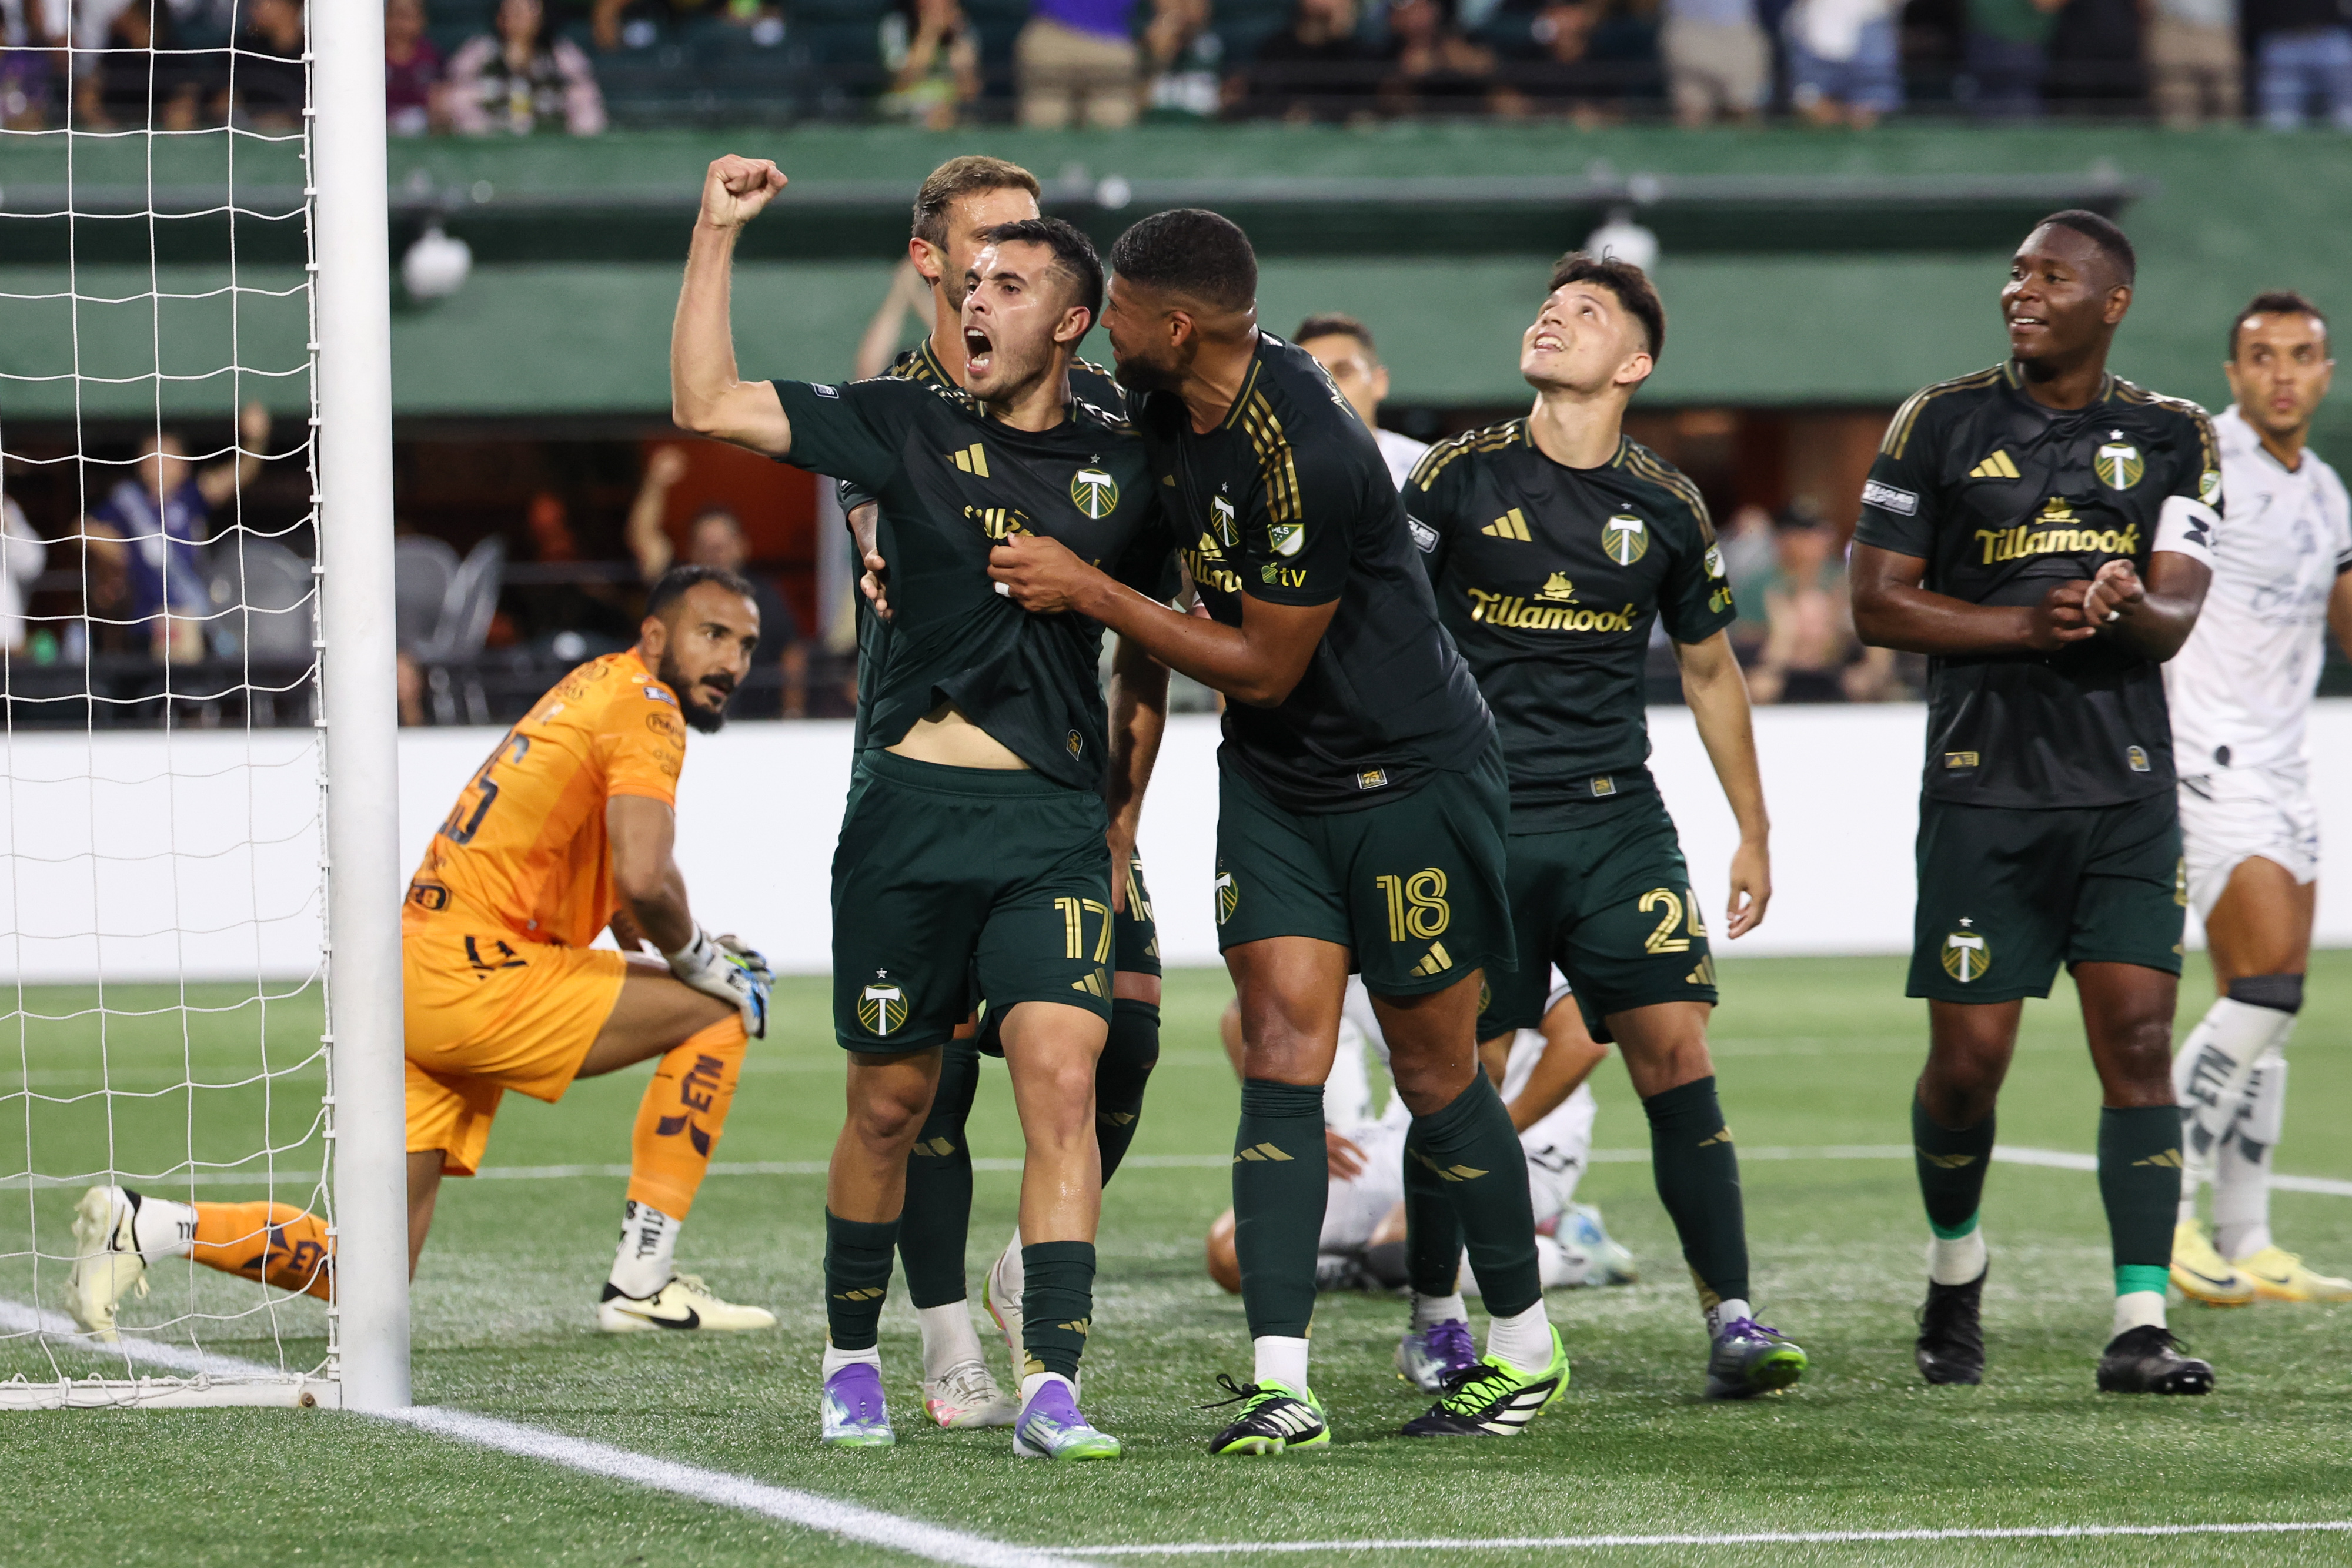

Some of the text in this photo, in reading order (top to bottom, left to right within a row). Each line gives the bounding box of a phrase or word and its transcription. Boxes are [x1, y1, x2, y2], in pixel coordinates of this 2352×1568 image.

[1271, 526, 1289, 534] MLS
[1974, 523, 2141, 564] Tillamook
[1279, 567, 1307, 587] tv
[1468, 587, 1638, 632] Tillamook
[1376, 867, 1451, 942] 18
[1054, 897, 1112, 964] 17
